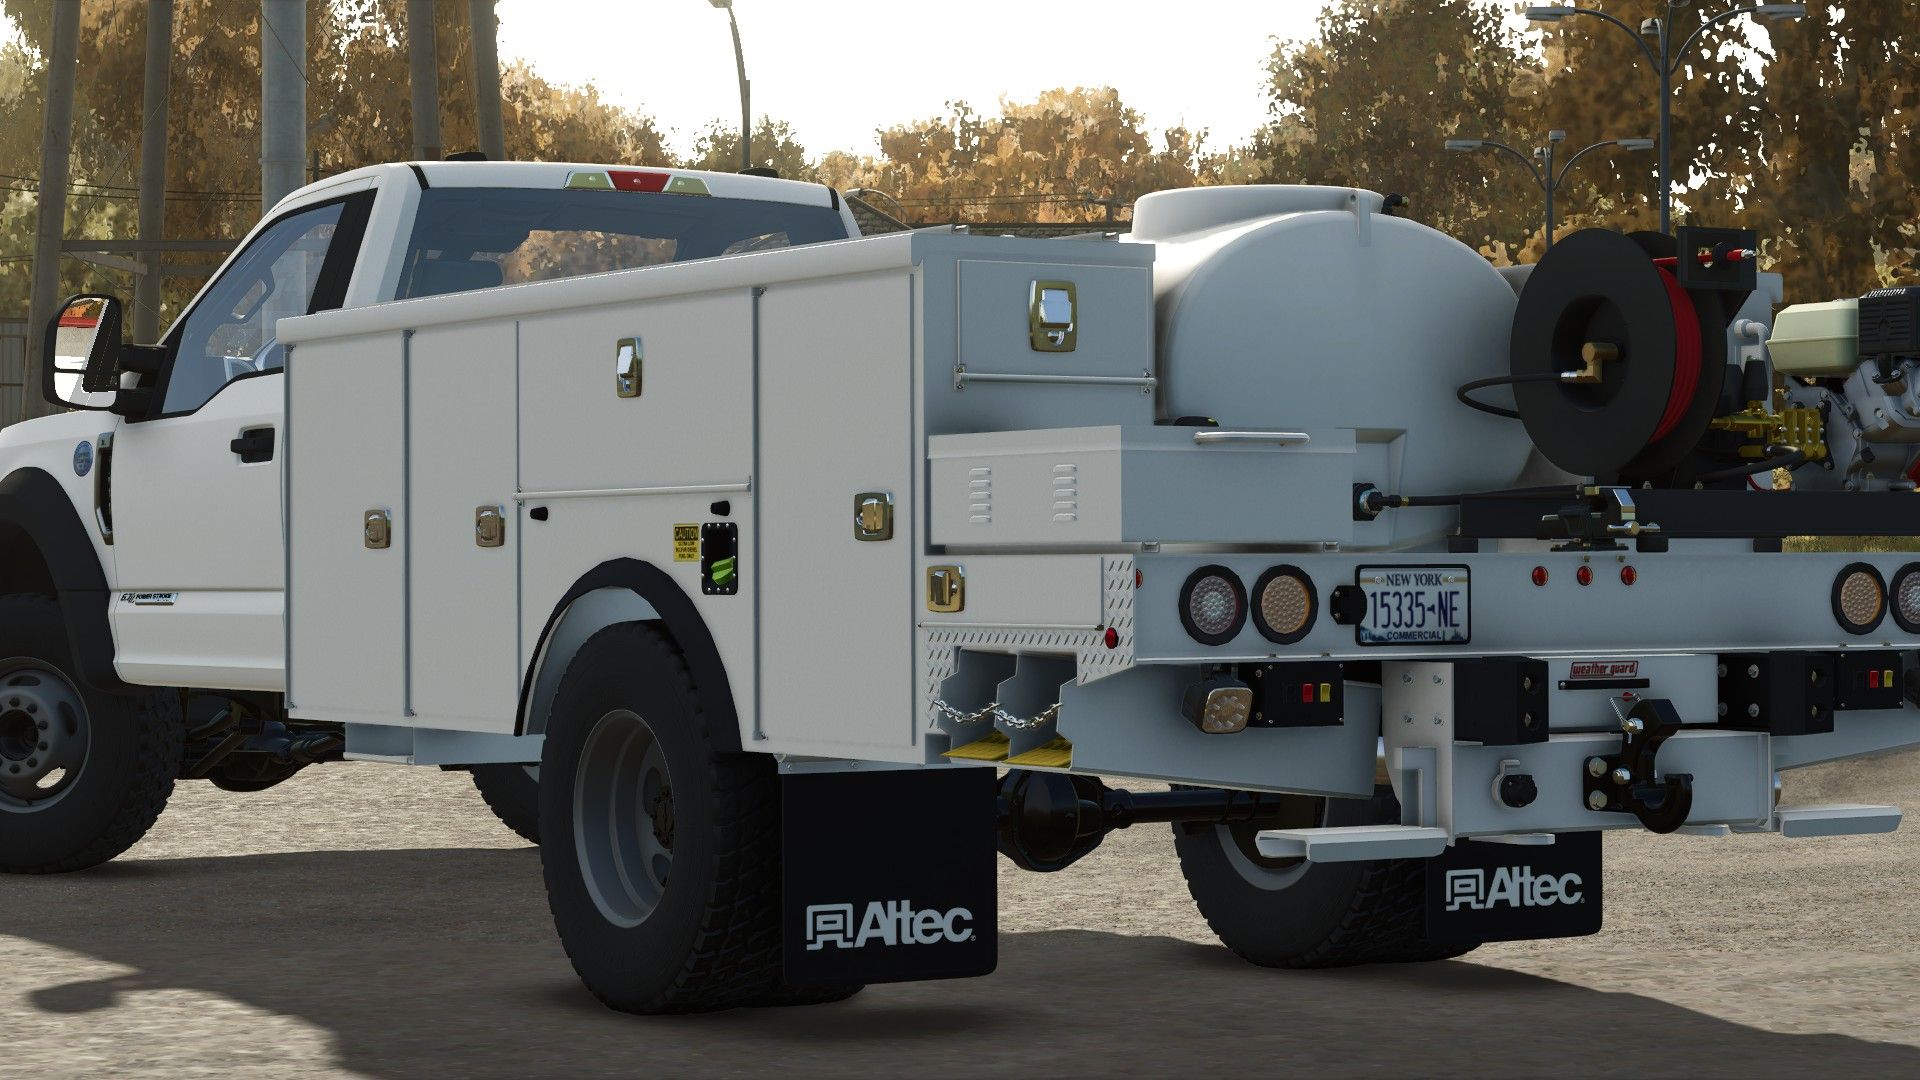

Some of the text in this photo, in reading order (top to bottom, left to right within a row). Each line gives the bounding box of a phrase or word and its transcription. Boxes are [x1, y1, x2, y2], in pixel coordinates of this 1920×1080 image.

[675, 527, 699, 540] CAUTION
[1386, 573, 1443, 587] NEW YORK
[1386, 630, 1442, 640] COMMERCIAL
[1572, 663, 1608, 675] weather
[1484, 865, 1583, 909] Altec
[854, 899, 974, 948] Altec
